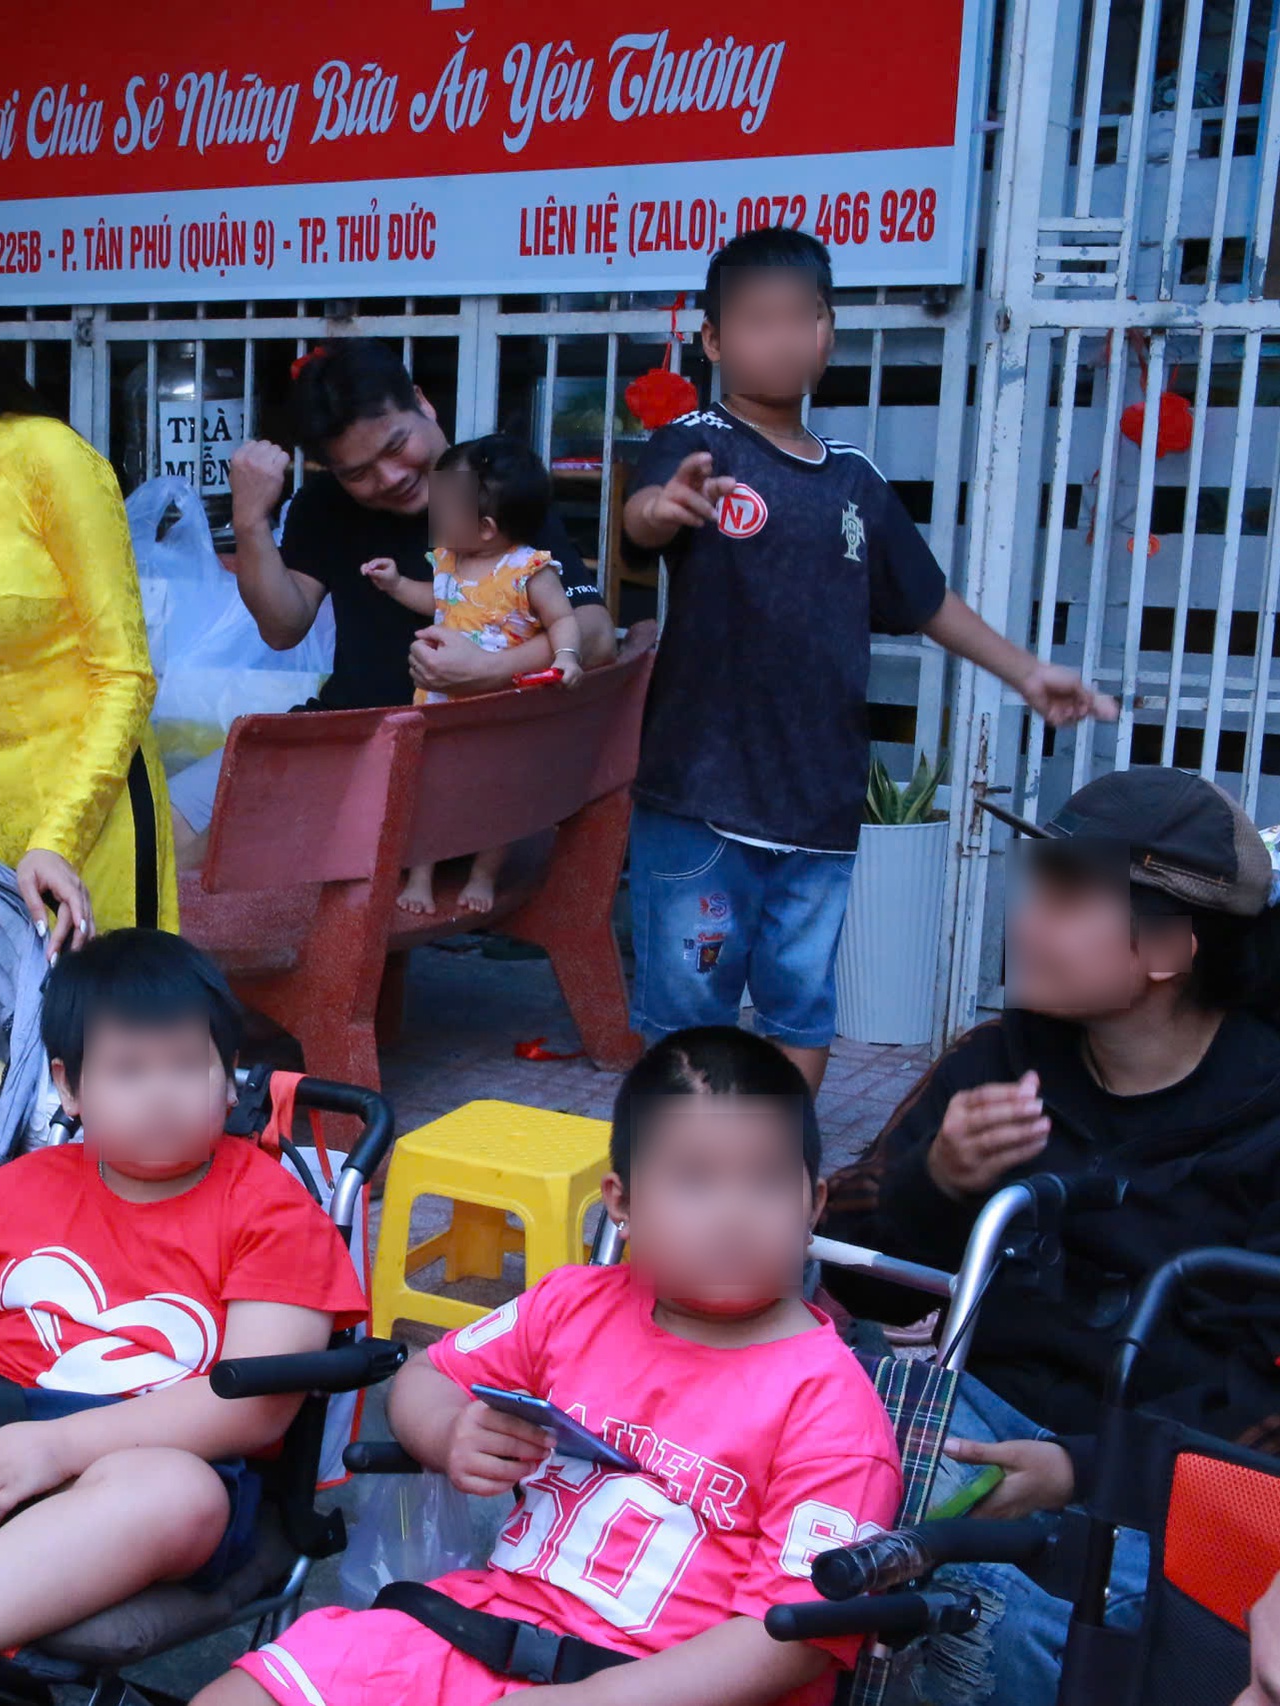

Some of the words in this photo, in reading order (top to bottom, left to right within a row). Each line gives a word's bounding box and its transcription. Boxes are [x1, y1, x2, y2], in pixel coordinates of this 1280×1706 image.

[26, 84, 104, 160] Chia
[113, 72, 169, 155] Sẻ
[175, 69, 300, 164] Những
[310, 59, 398, 145] Bữa
[409, 29, 489, 134] Ăn
[502, 40, 595, 154] Yêu
[607, 29, 786, 134] Thương
[62, 229, 77, 272] P.
[84, 217, 122, 272] TÂN
[129, 214, 171, 270] PHÚ
[180, 211, 246, 277] (QUẬN
[253, 219, 275, 271] 9)
[299, 217, 328, 264] TP.
[336, 197, 380, 262] THỦ
[388, 203, 436, 262] ĐỨC
[519, 196, 576, 257] LIÊN
[585, 192, 618, 265] HỆ
[628, 197, 726, 258] (ZALO):
[815, 191, 870, 245] 466
[879, 187, 937, 244] 928
[167, 408, 232, 443] TRÀ
